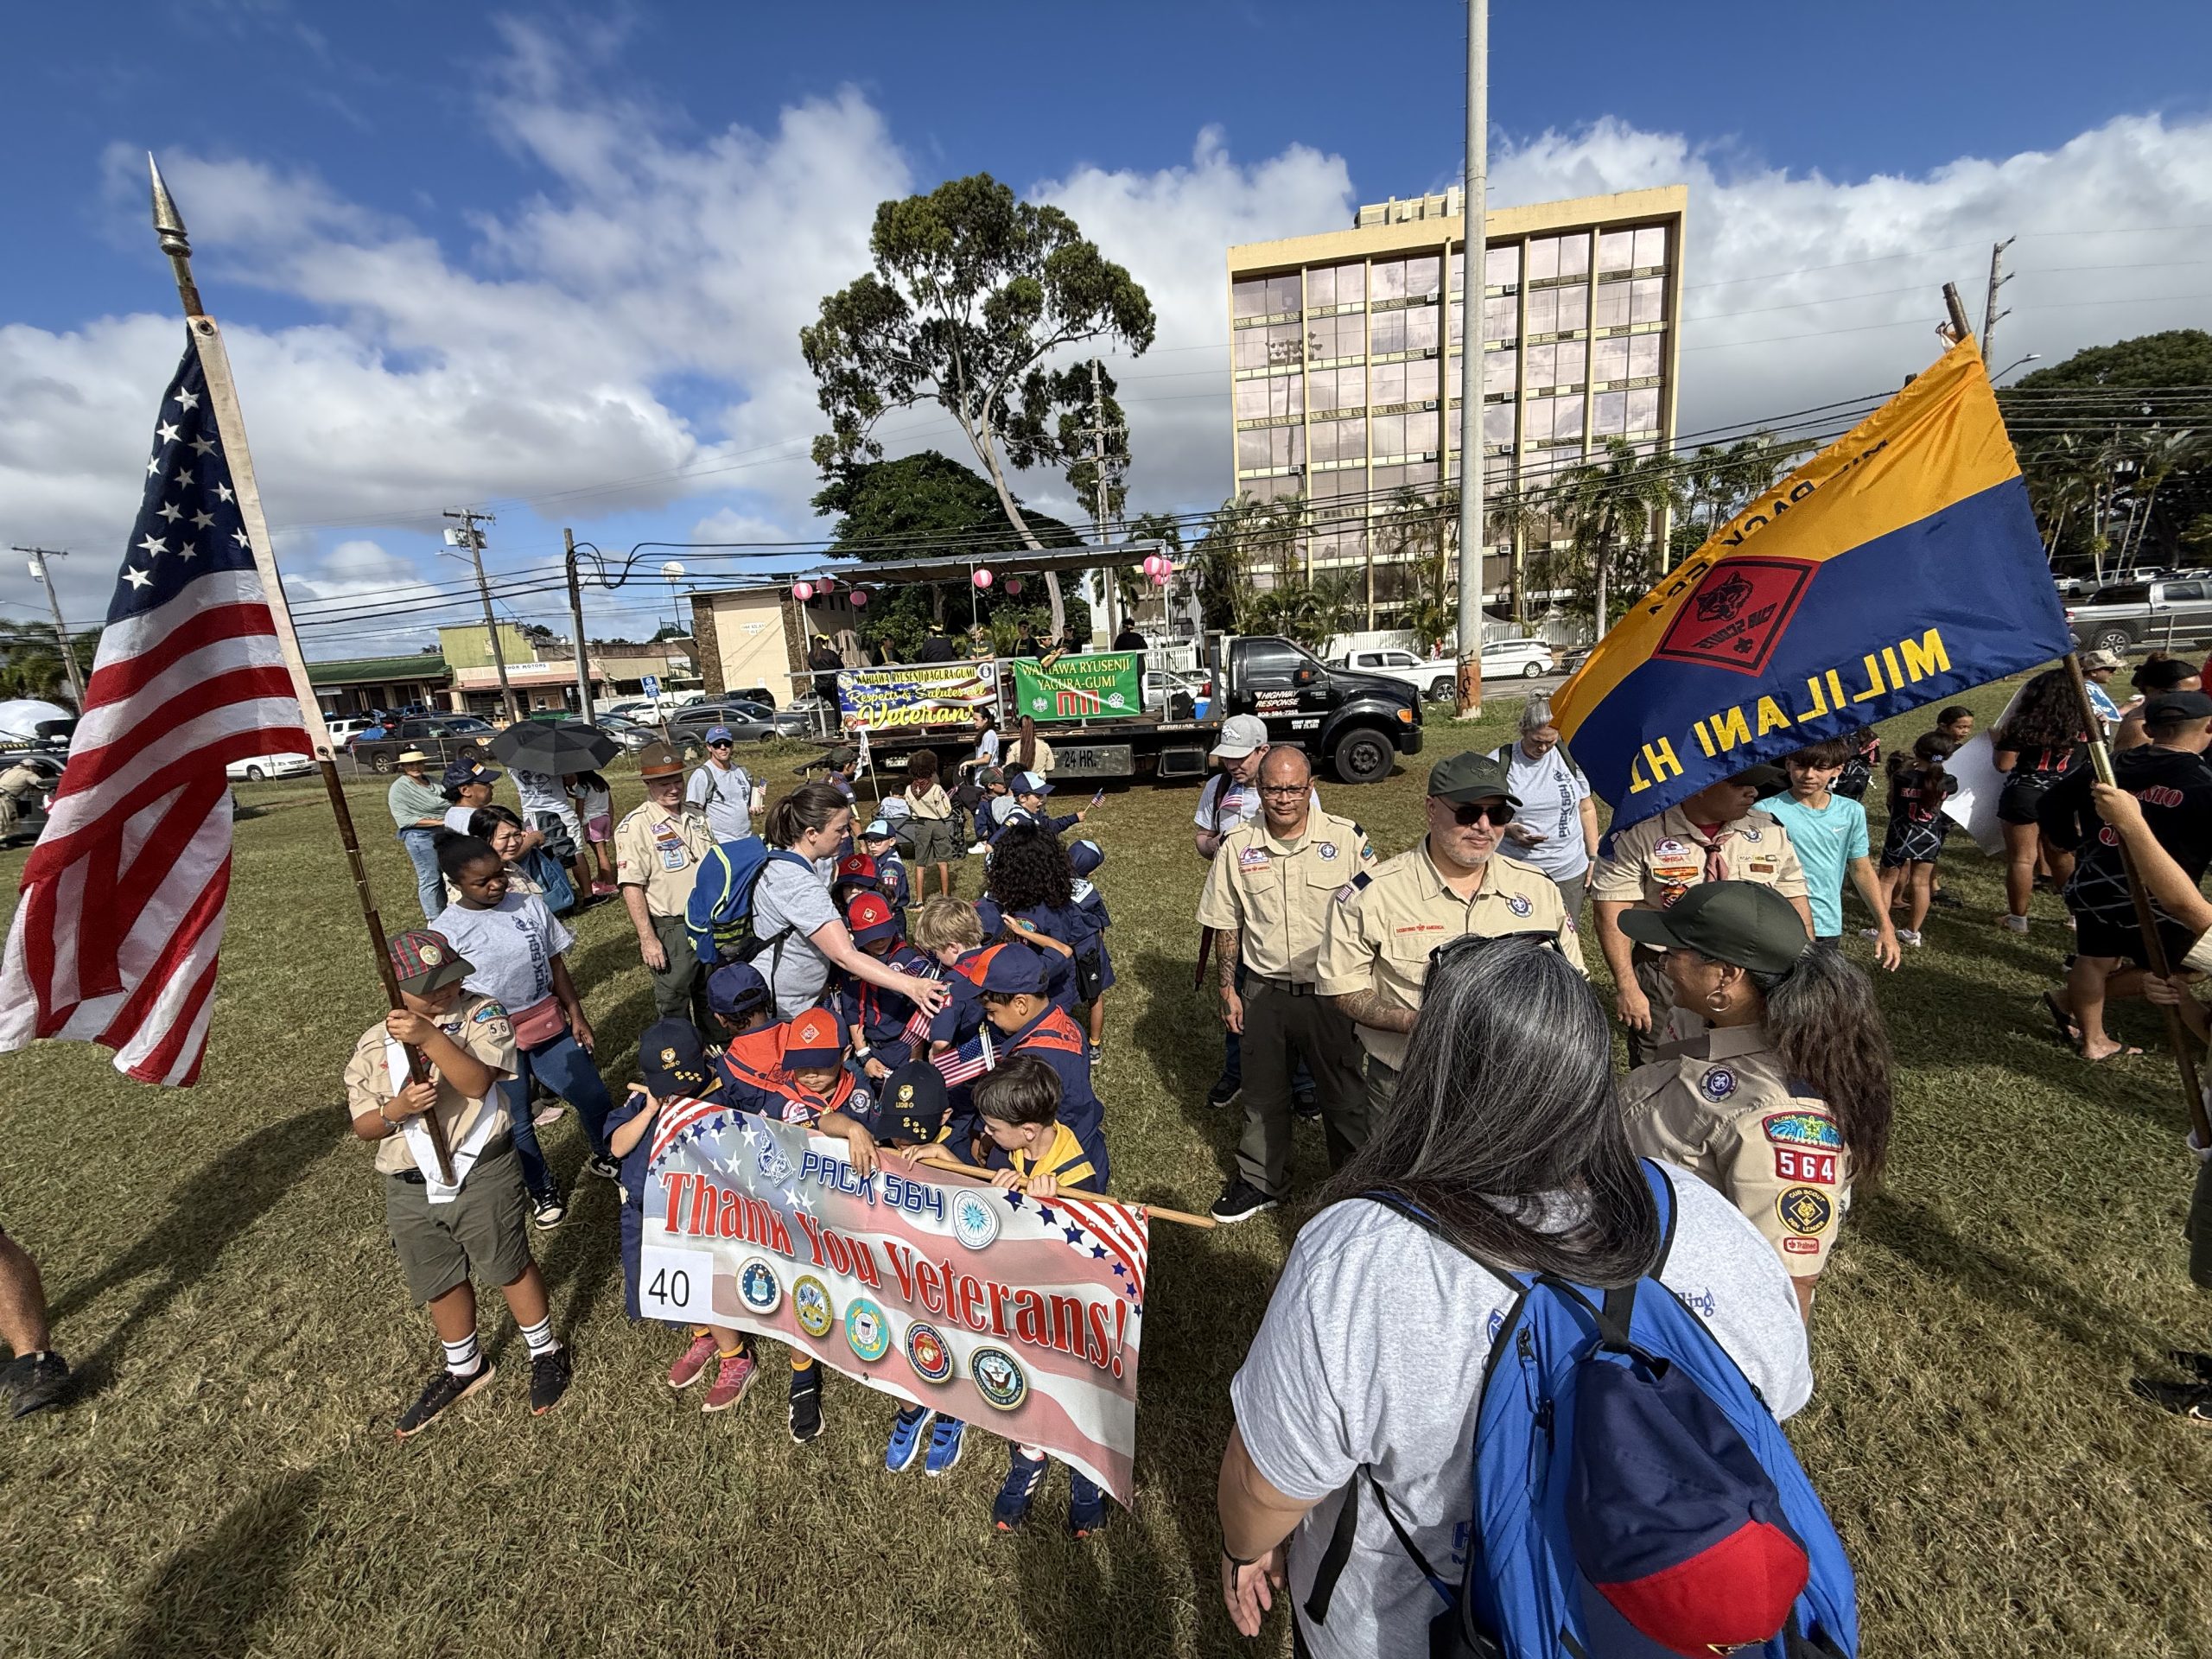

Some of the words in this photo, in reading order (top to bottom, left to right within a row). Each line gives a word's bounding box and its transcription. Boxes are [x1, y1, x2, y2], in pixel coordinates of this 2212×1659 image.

[1022, 664, 1077, 677] WAHIAWA
[1080, 658, 1131, 673] RYUSENJI
[855, 672, 890, 685] WAHIAWA
[1037, 675, 1116, 691] YAGURA-GUMI
[846, 690, 899, 705] Respects
[901, 689, 912, 699] &
[914, 687, 964, 699] Salutes
[1255, 698, 1300, 708] RESPONSE
[1262, 690, 1300, 700] HIGHWAY
[1065, 750, 1077, 767] 24
[1080, 749, 1097, 767] HR.
[1558, 784, 1572, 807] 564
[1558, 808, 1571, 838] PACK
[524, 933, 542, 963] 564
[1773, 1114, 1797, 1124] ALOHA
[1780, 1152, 1834, 1181] 564
[798, 1149, 875, 1206] PACK
[882, 1171, 944, 1222] 564
[1789, 1190, 1802, 1199] CUB
[1803, 1189, 1826, 1203] SCOUT
[1787, 1217, 1801, 1230] DEN
[1802, 1220, 1825, 1232] LEADER
[1796, 1240, 1817, 1250] Trained
[661, 1171, 795, 1257] Thank
[794, 1210, 881, 1289] You
[882, 1242, 1128, 1380] Veterans!
[648, 1268, 690, 1307] 40
